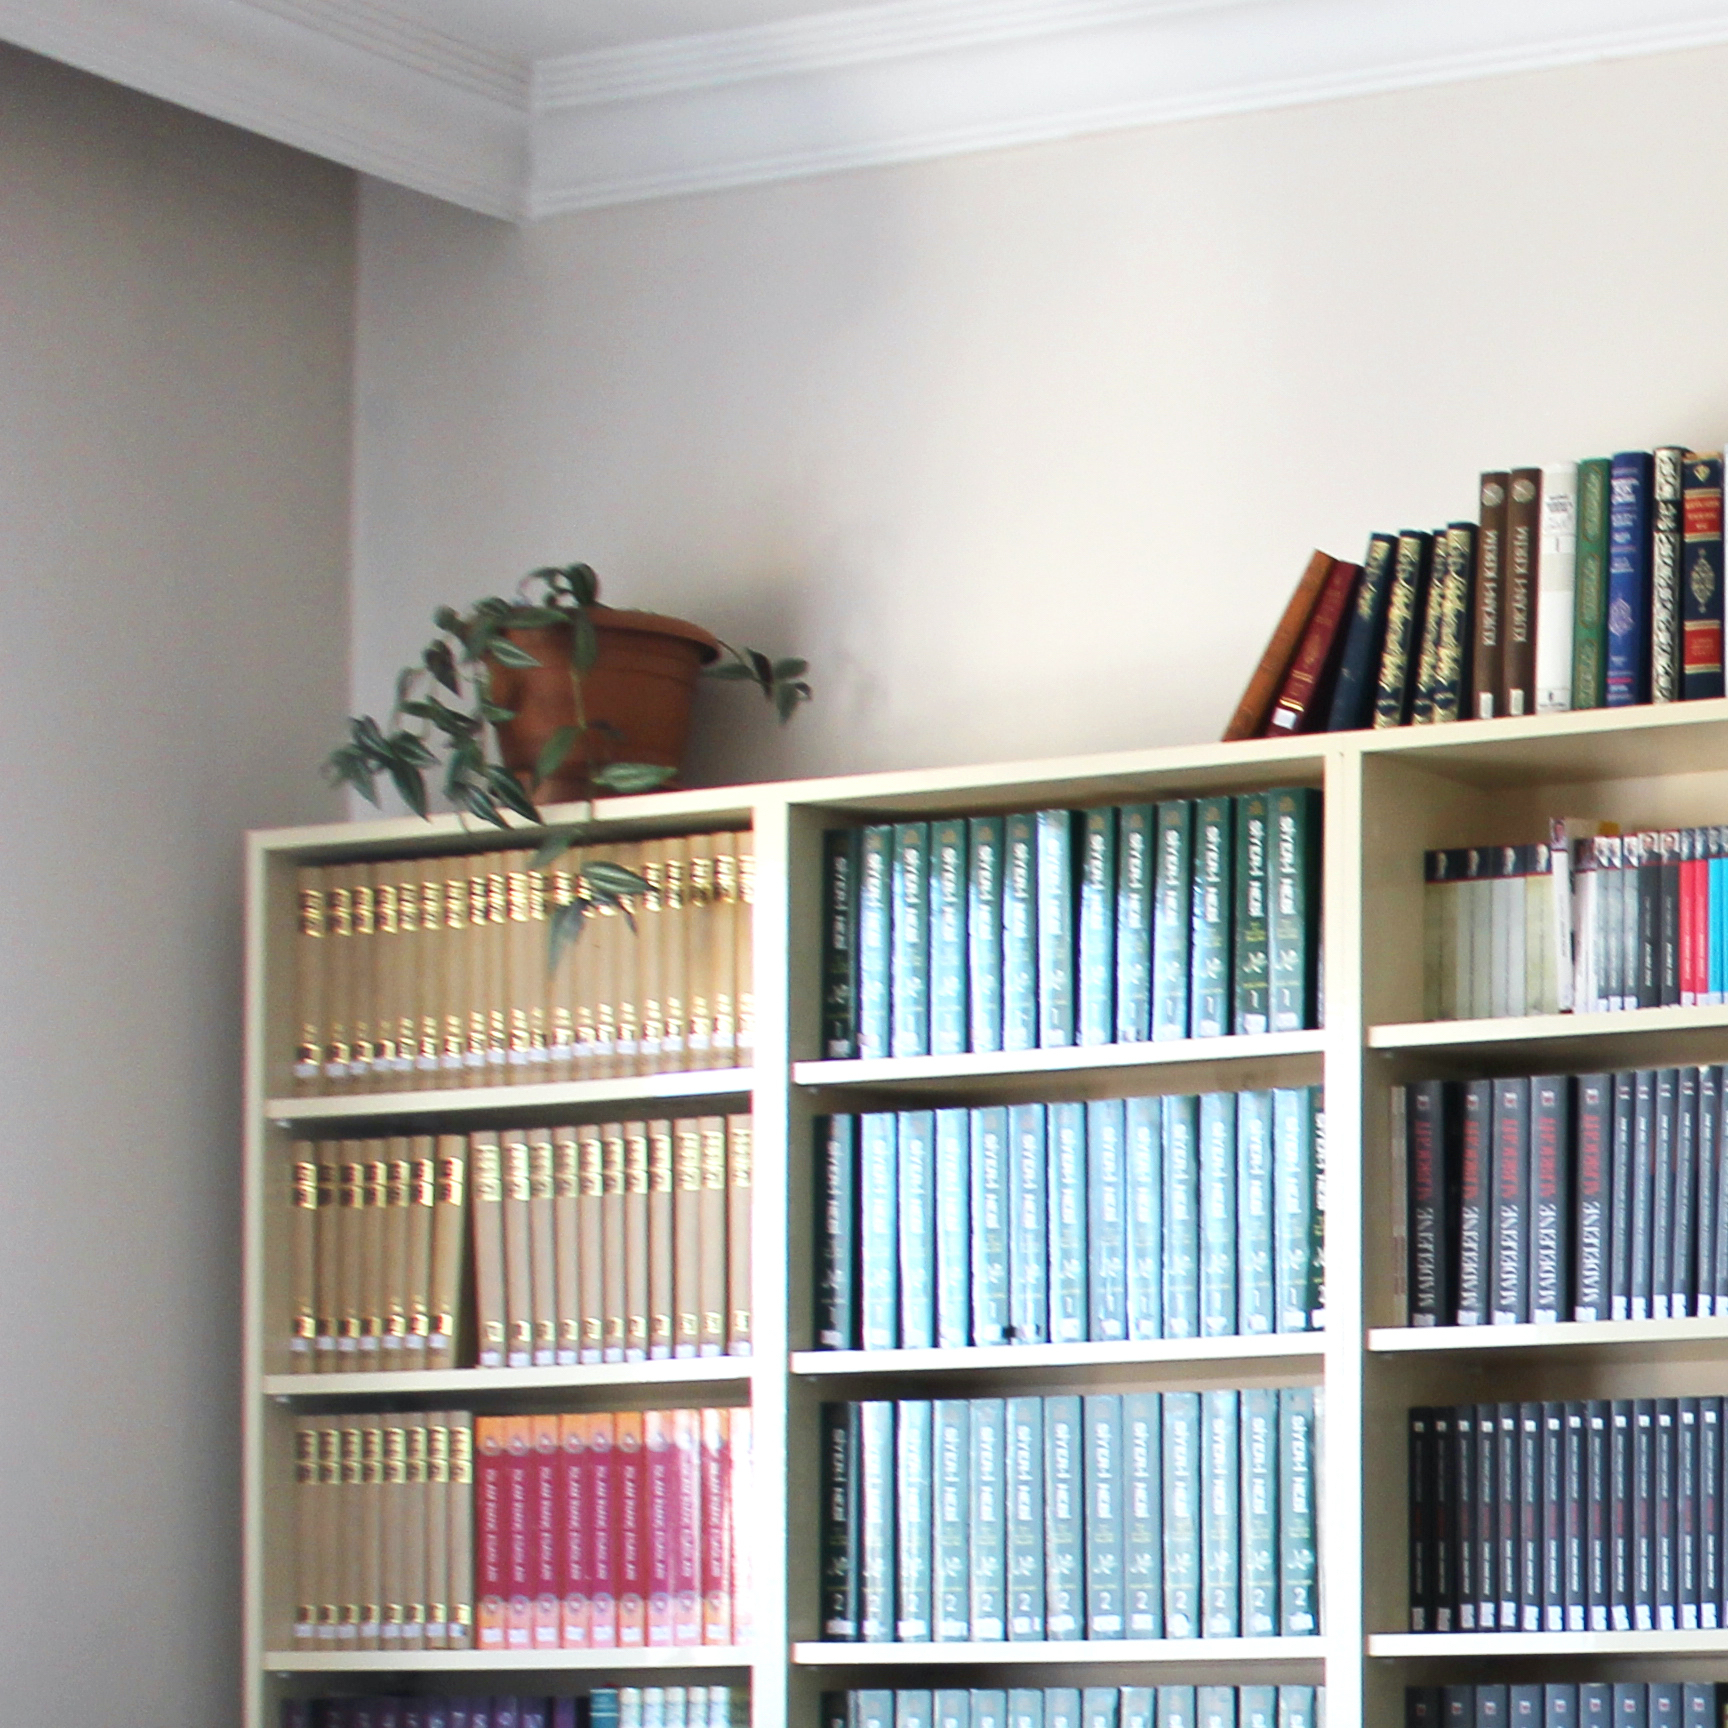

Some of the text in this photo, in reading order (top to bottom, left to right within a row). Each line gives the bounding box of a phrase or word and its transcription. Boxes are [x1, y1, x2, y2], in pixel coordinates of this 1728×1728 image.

[1417, 1208, 1435, 1306] MADELEINE
[1461, 1206, 1479, 1306] MADELEINE
[1500, 1205, 1519, 1305] MADELEINE
[1539, 1204, 1557, 1304] MADELEINE
[1583, 1201, 1600, 1302] MADELEINE
